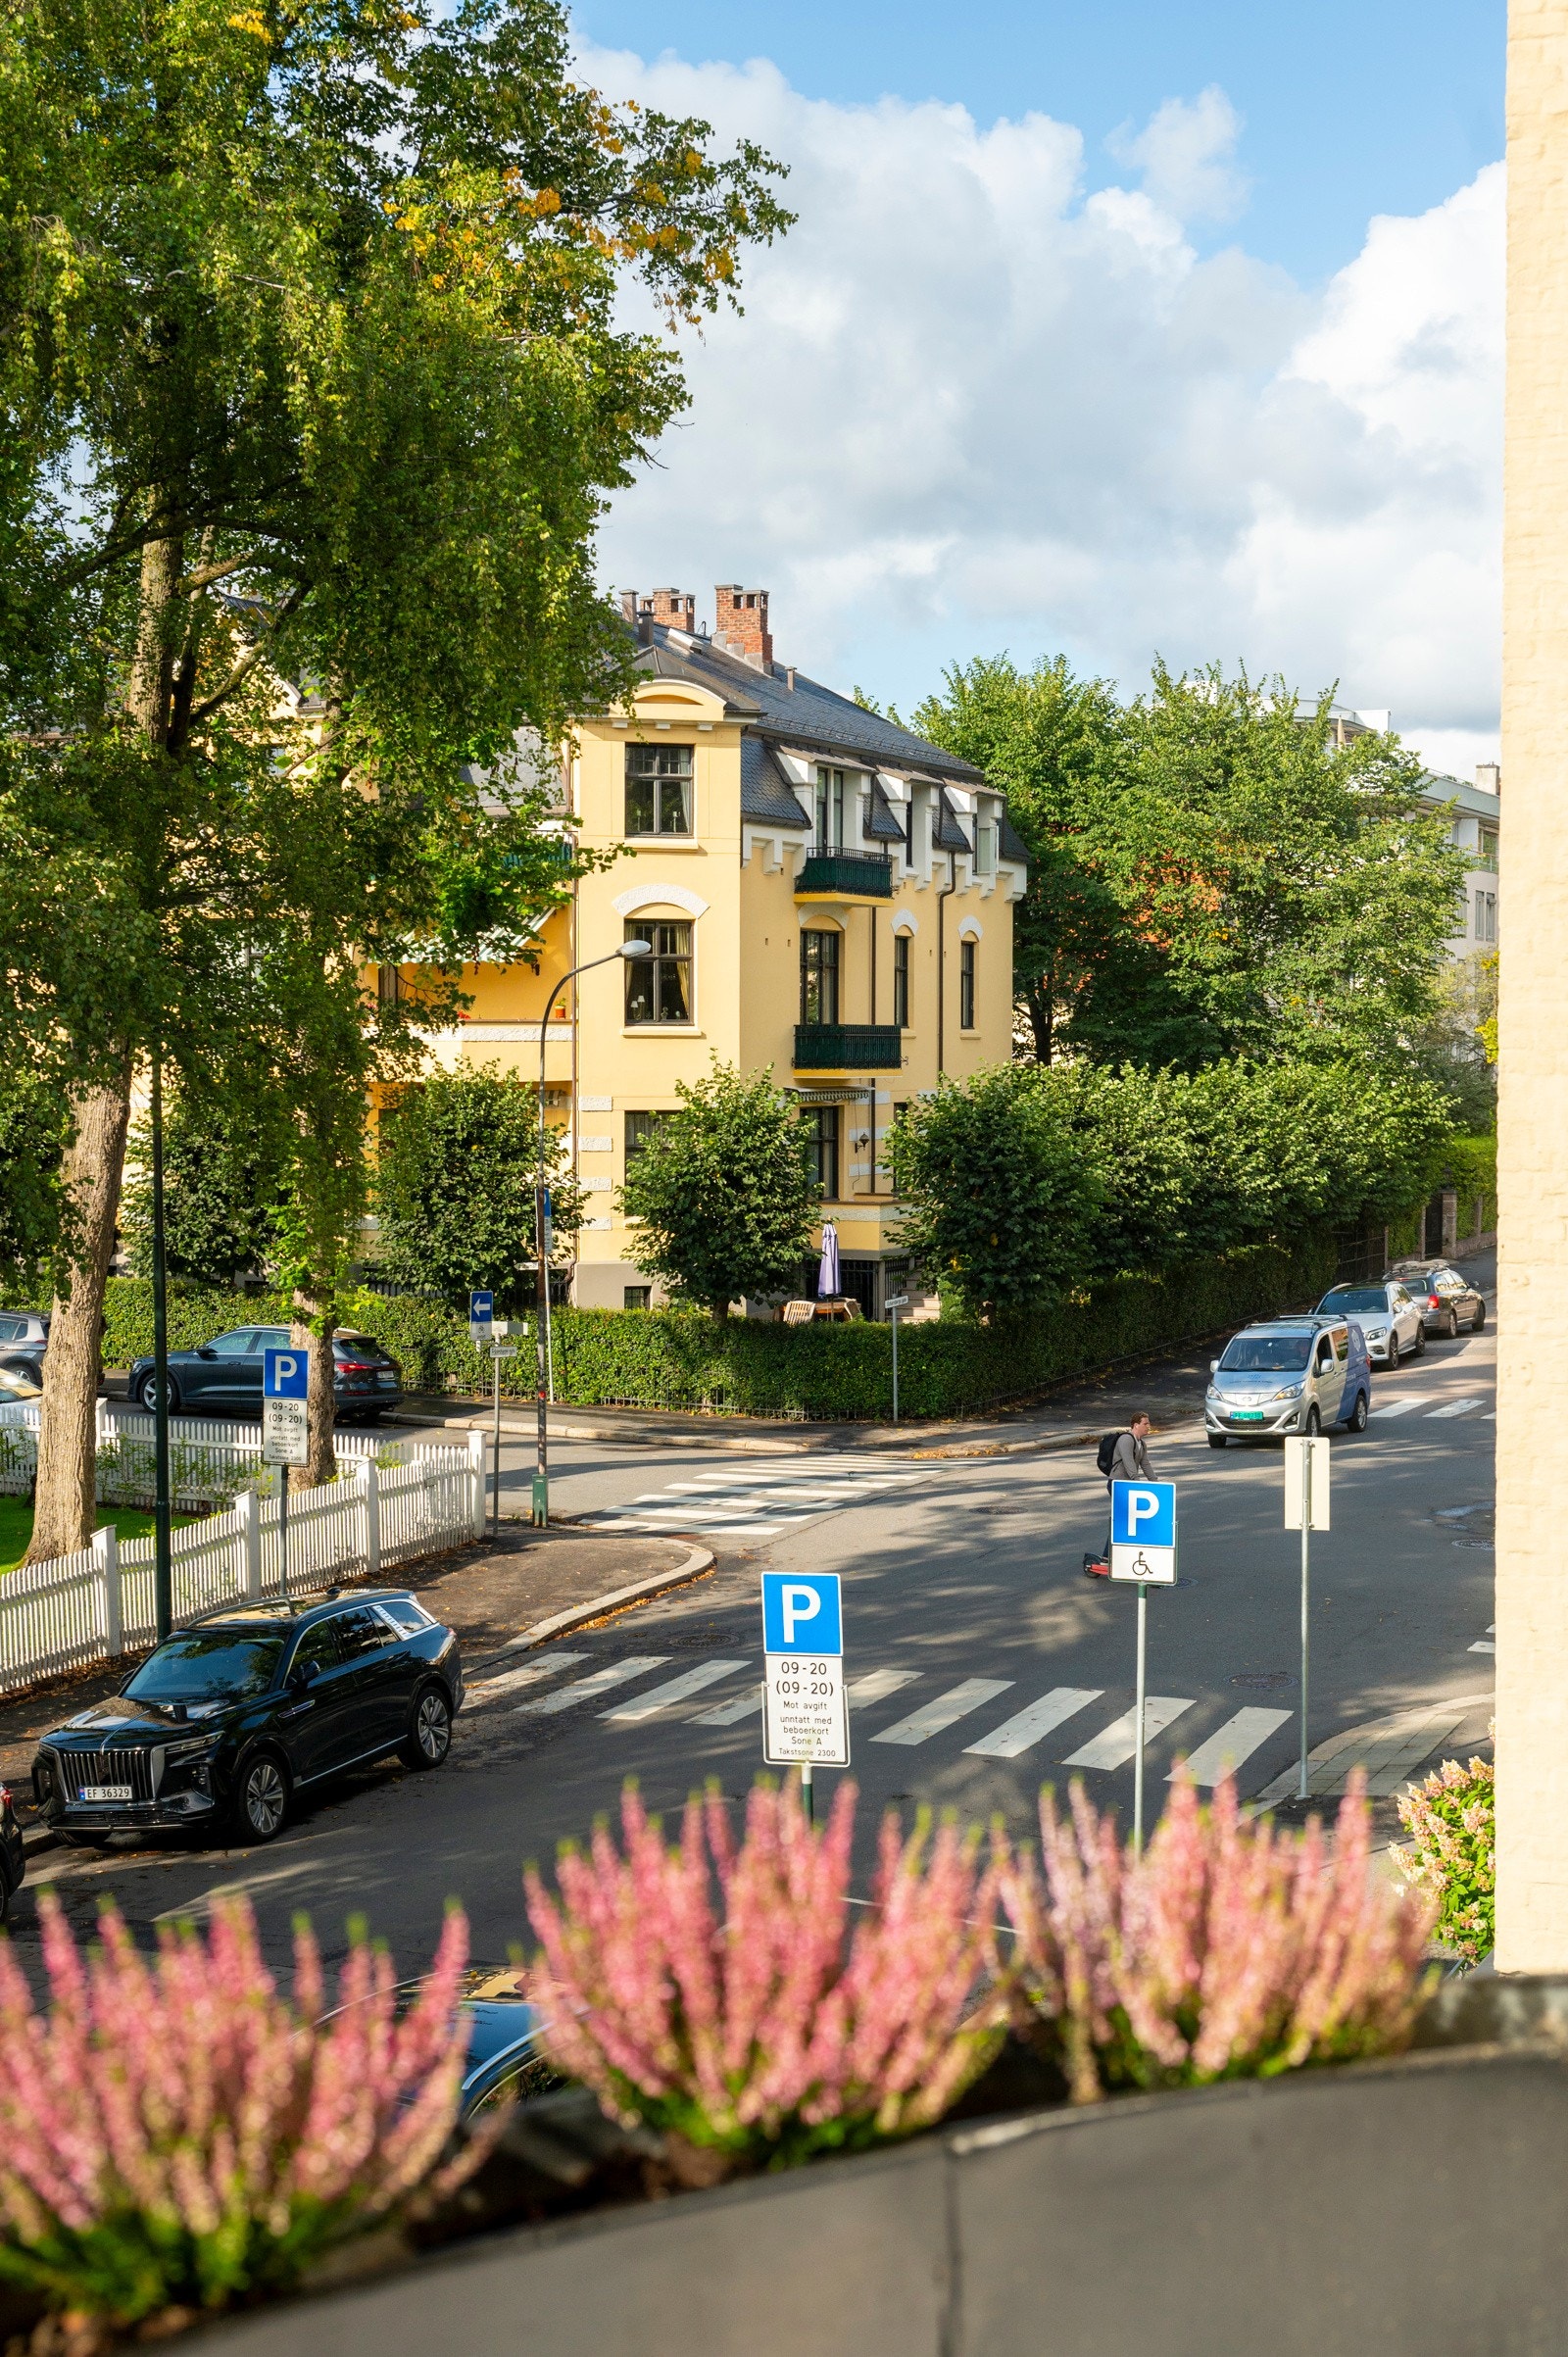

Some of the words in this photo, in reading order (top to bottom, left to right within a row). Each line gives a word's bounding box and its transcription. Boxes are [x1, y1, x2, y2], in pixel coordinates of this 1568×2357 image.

[274, 1354, 298, 1392] P
[1127, 1490, 1160, 1537] P
[781, 1584, 822, 1644] P
[783, 1700, 799, 1709] Mot
[803, 1701, 828, 1712] avgift
[780, 1715, 810, 1724] unntatt
[814, 1716, 832, 1725] med
[783, 1725, 829, 1735] beboerkort
[791, 1736, 812, 1745] Sone
[816, 1737, 823, 1745] A
[778, 1747, 814, 1756] Takstsone
[817, 1748, 836, 1757] 2300
[87, 1789, 97, 1798] EF
[101, 1788, 130, 1798] 36329
